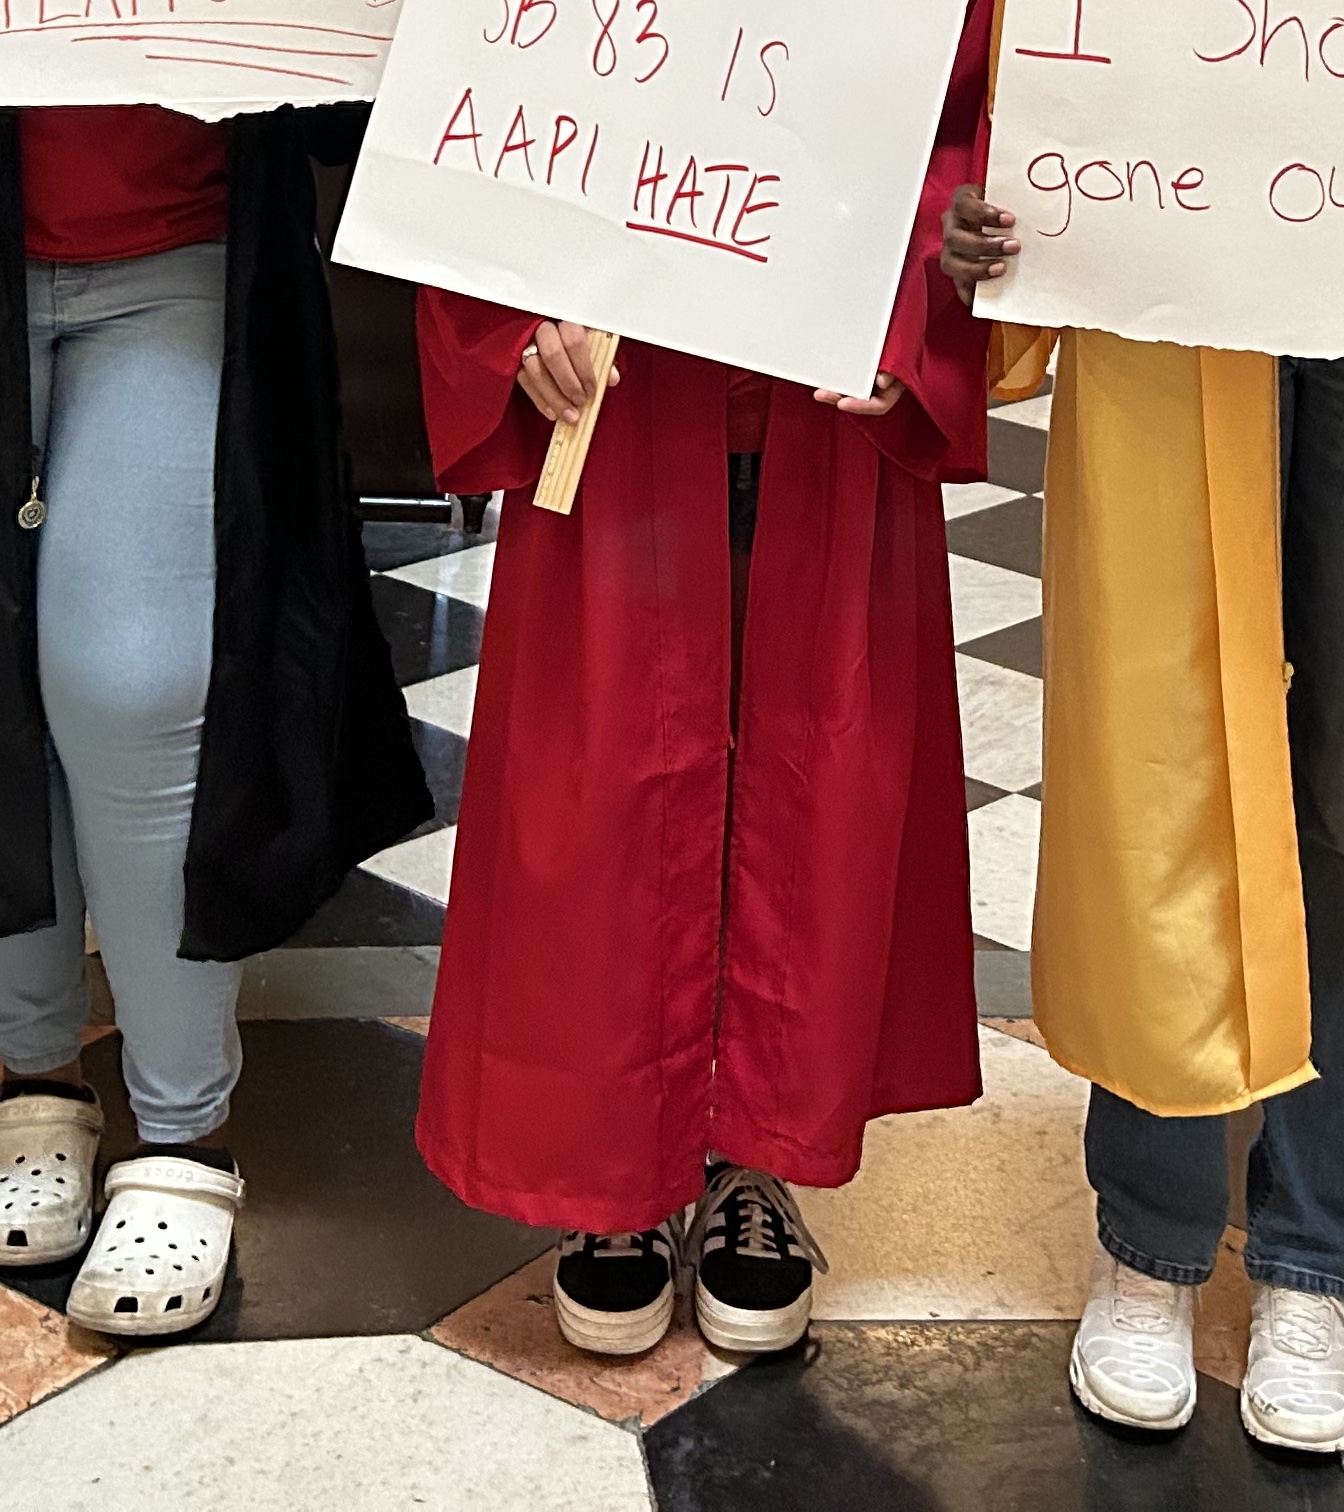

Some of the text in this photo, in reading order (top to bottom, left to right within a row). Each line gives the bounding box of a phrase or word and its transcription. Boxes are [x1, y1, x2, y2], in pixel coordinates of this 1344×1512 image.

[720, 27, 790, 117] IS
[433, 88, 782, 247] AAPI HATE
[1025, 151, 1212, 238] gone
